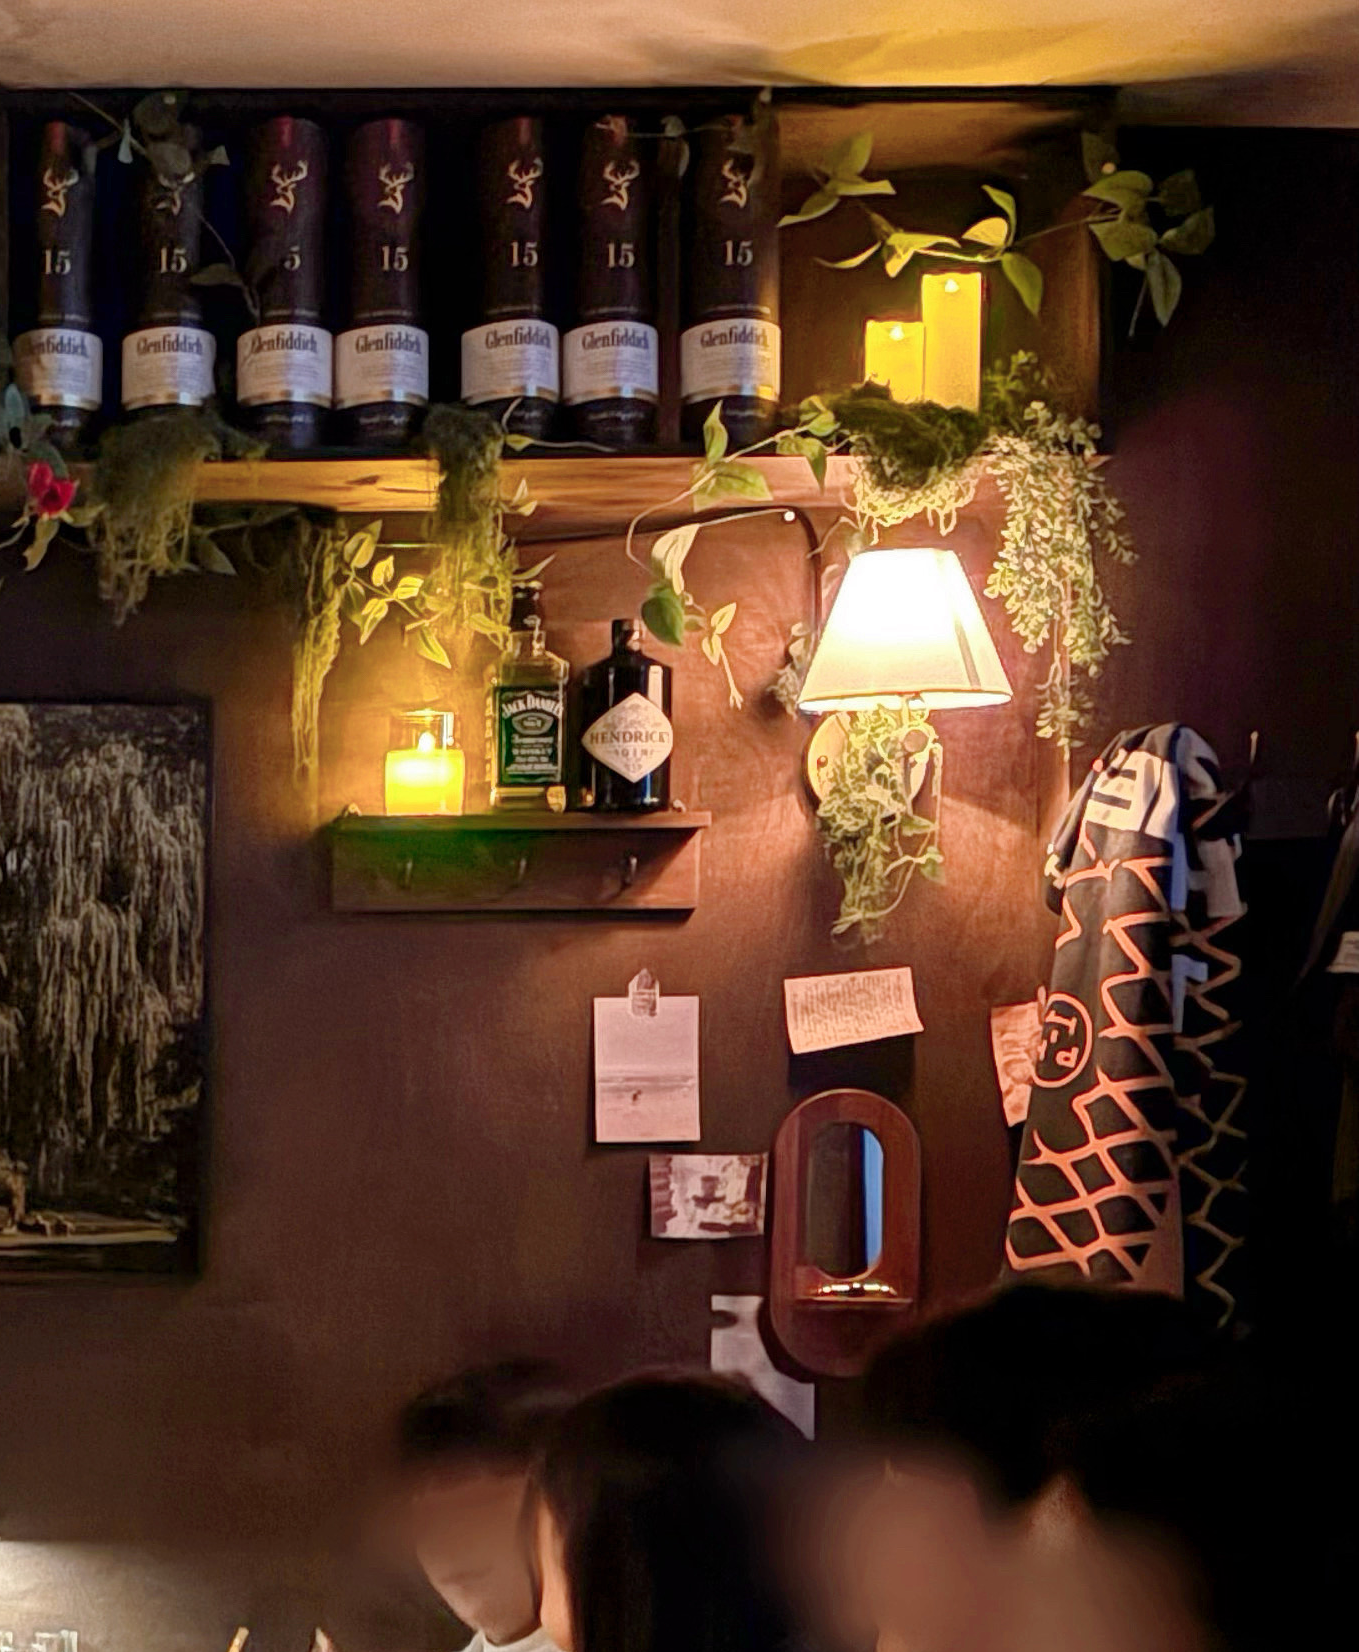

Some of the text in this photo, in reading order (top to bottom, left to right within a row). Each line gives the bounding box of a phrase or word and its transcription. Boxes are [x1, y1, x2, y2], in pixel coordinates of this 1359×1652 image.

[44, 249, 72, 275] 15
[160, 247, 187, 274] 15
[284, 246, 301, 271] 5
[382, 246, 408, 272] 15
[510, 241, 538, 267] 15
[608, 243, 635, 268] 15
[724, 240, 753, 266] 15
[486, 325, 550, 350] Glenfiddich
[582, 327, 649, 350] Glenfiddich
[700, 325, 769, 348] Glenfiddich
